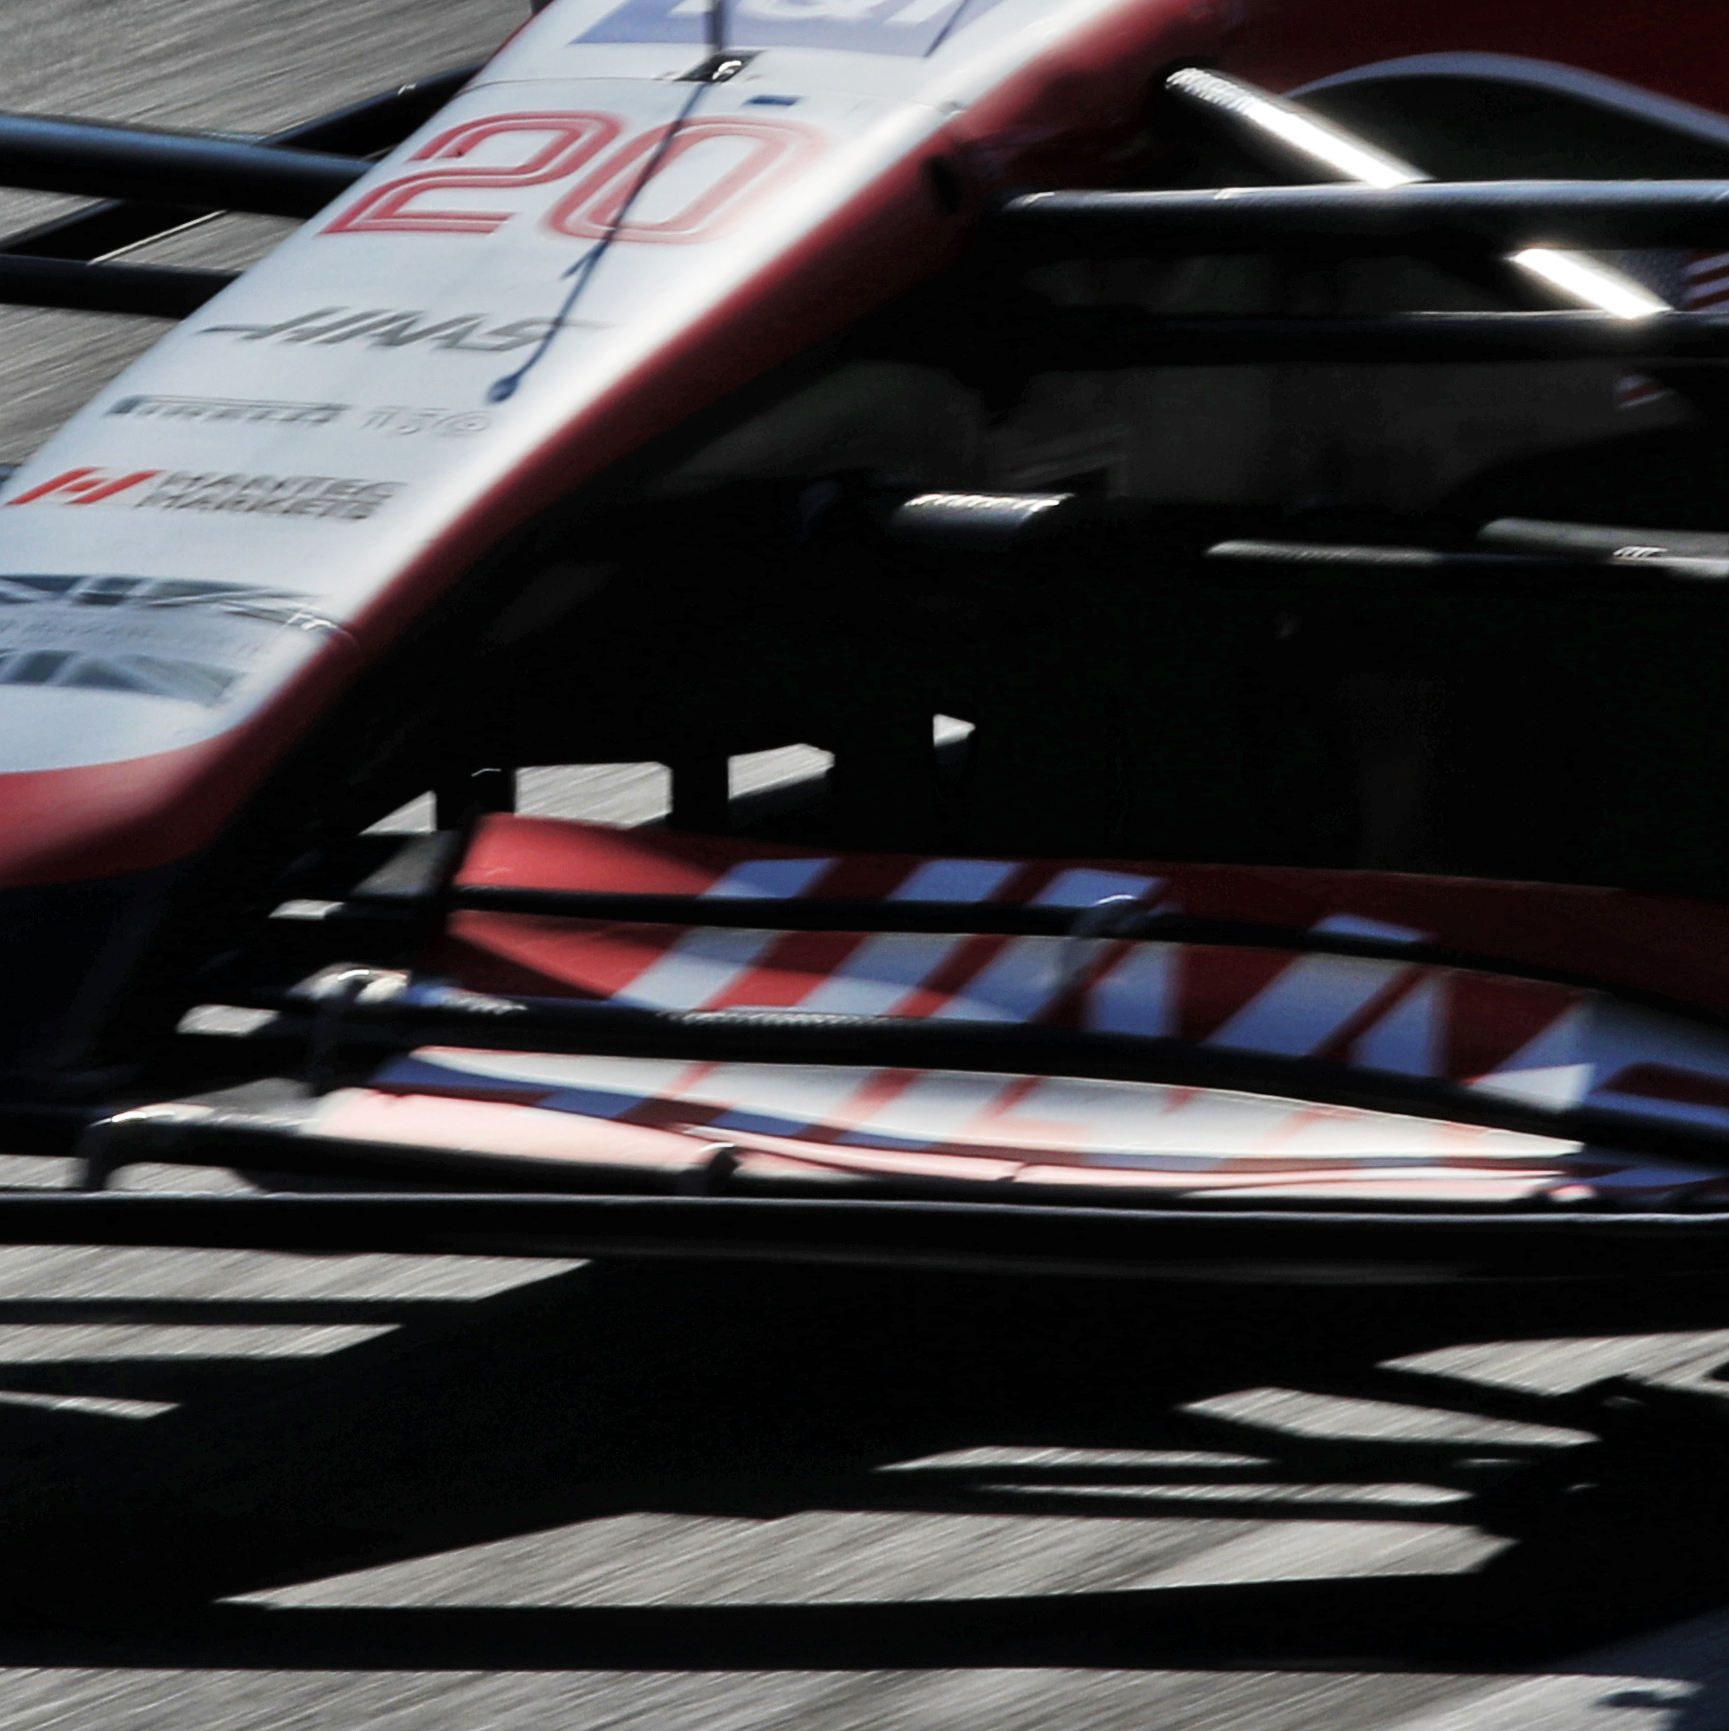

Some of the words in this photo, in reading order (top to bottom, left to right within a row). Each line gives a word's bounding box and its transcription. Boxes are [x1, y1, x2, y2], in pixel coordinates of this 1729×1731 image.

[314, 111, 832, 245] 20
[198, 305, 604, 353] HAAS
[158, 471, 407, 499] HANTEC
[134, 492, 384, 520] MARKETS
